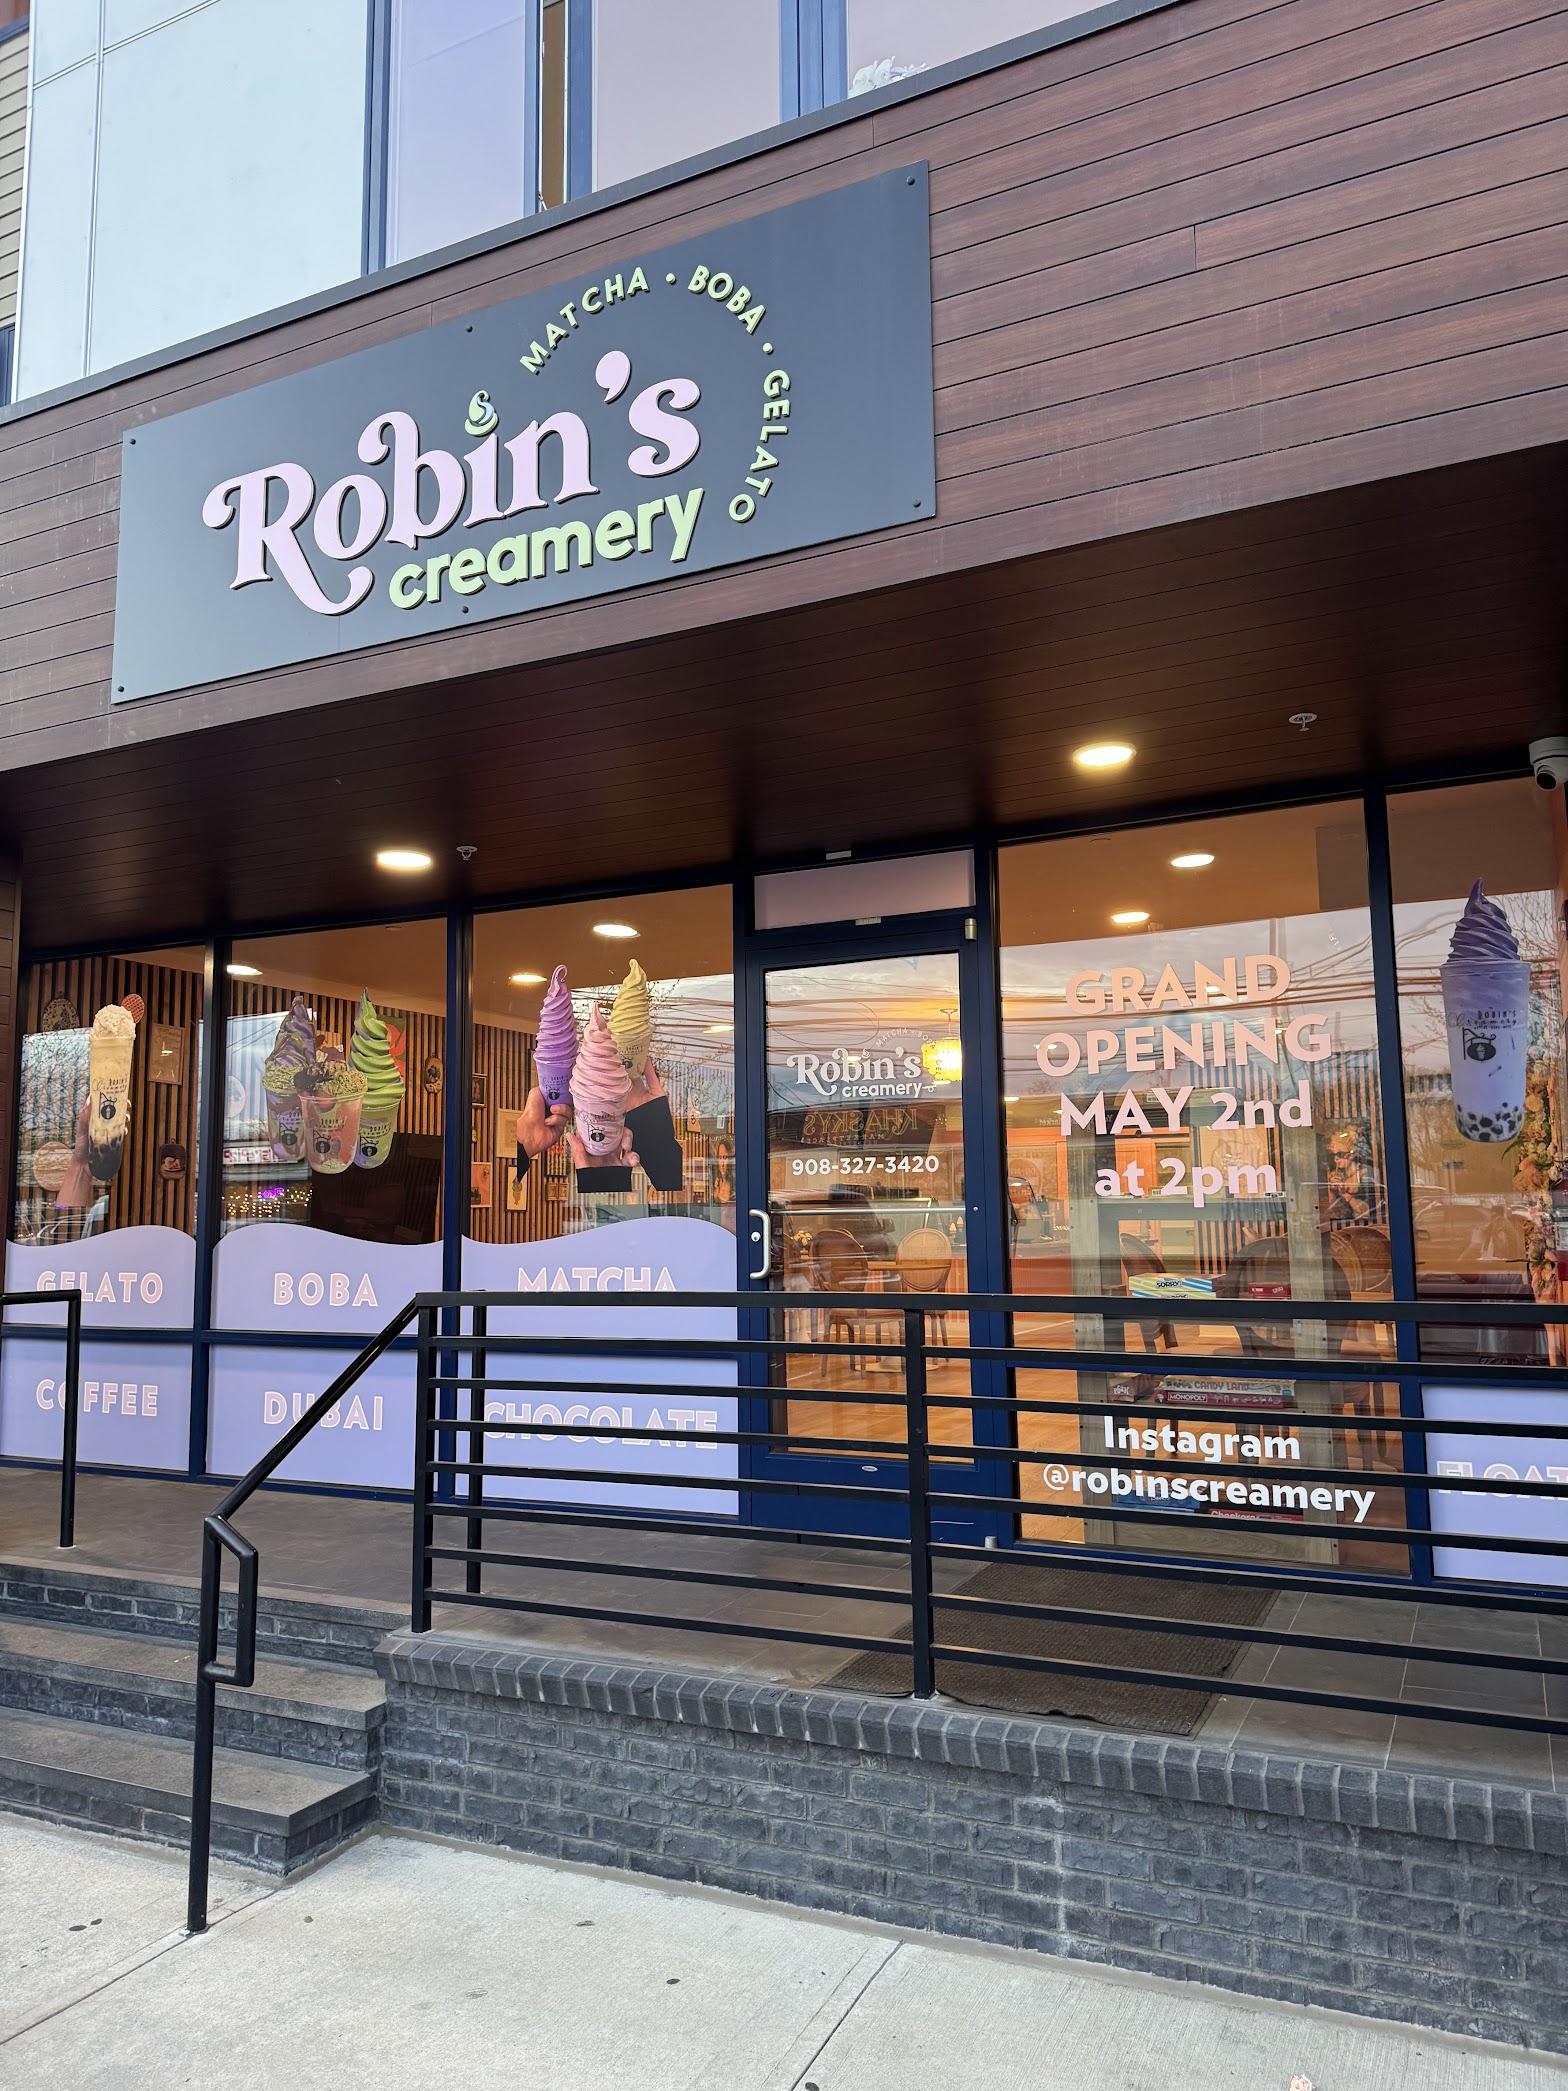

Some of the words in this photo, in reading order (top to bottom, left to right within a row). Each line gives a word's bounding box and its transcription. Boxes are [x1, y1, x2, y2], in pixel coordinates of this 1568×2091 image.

[519, 265, 652, 376] MATCHA
[688, 264, 768, 335] BOBA
[728, 368, 792, 523] GELATO
[202, 349, 702, 616] Robin's
[389, 487, 705, 612] creamery
[1065, 954, 1292, 1016] GRAND
[1036, 1014, 1332, 1077] OPENING
[786, 1046, 922, 1096] Robin's
[842, 1082, 923, 1099] creamery
[1061, 1085, 1195, 1137] MAY
[1210, 1079, 1313, 1131] 2nd
[791, 1155, 940, 1177] 908-327-3420
[1095, 1160, 1145, 1197] at
[1159, 1157, 1277, 1208] 2pm
[36, 1270, 163, 1304] GELATO
[273, 1272, 378, 1307] BOBA
[516, 1266, 676, 1292] MATCHA
[1169, 1393, 1207, 1401] MONOPOLY
[1194, 1381, 1223, 1390] CANDY
[1227, 1382, 1249, 1391] LAND
[264, 1390, 383, 1431] DUBAI
[484, 1401, 718, 1449] CHOCOLATE
[1104, 1415, 1300, 1463] Instagram
[1042, 1462, 1376, 1523] @robinscreamery
